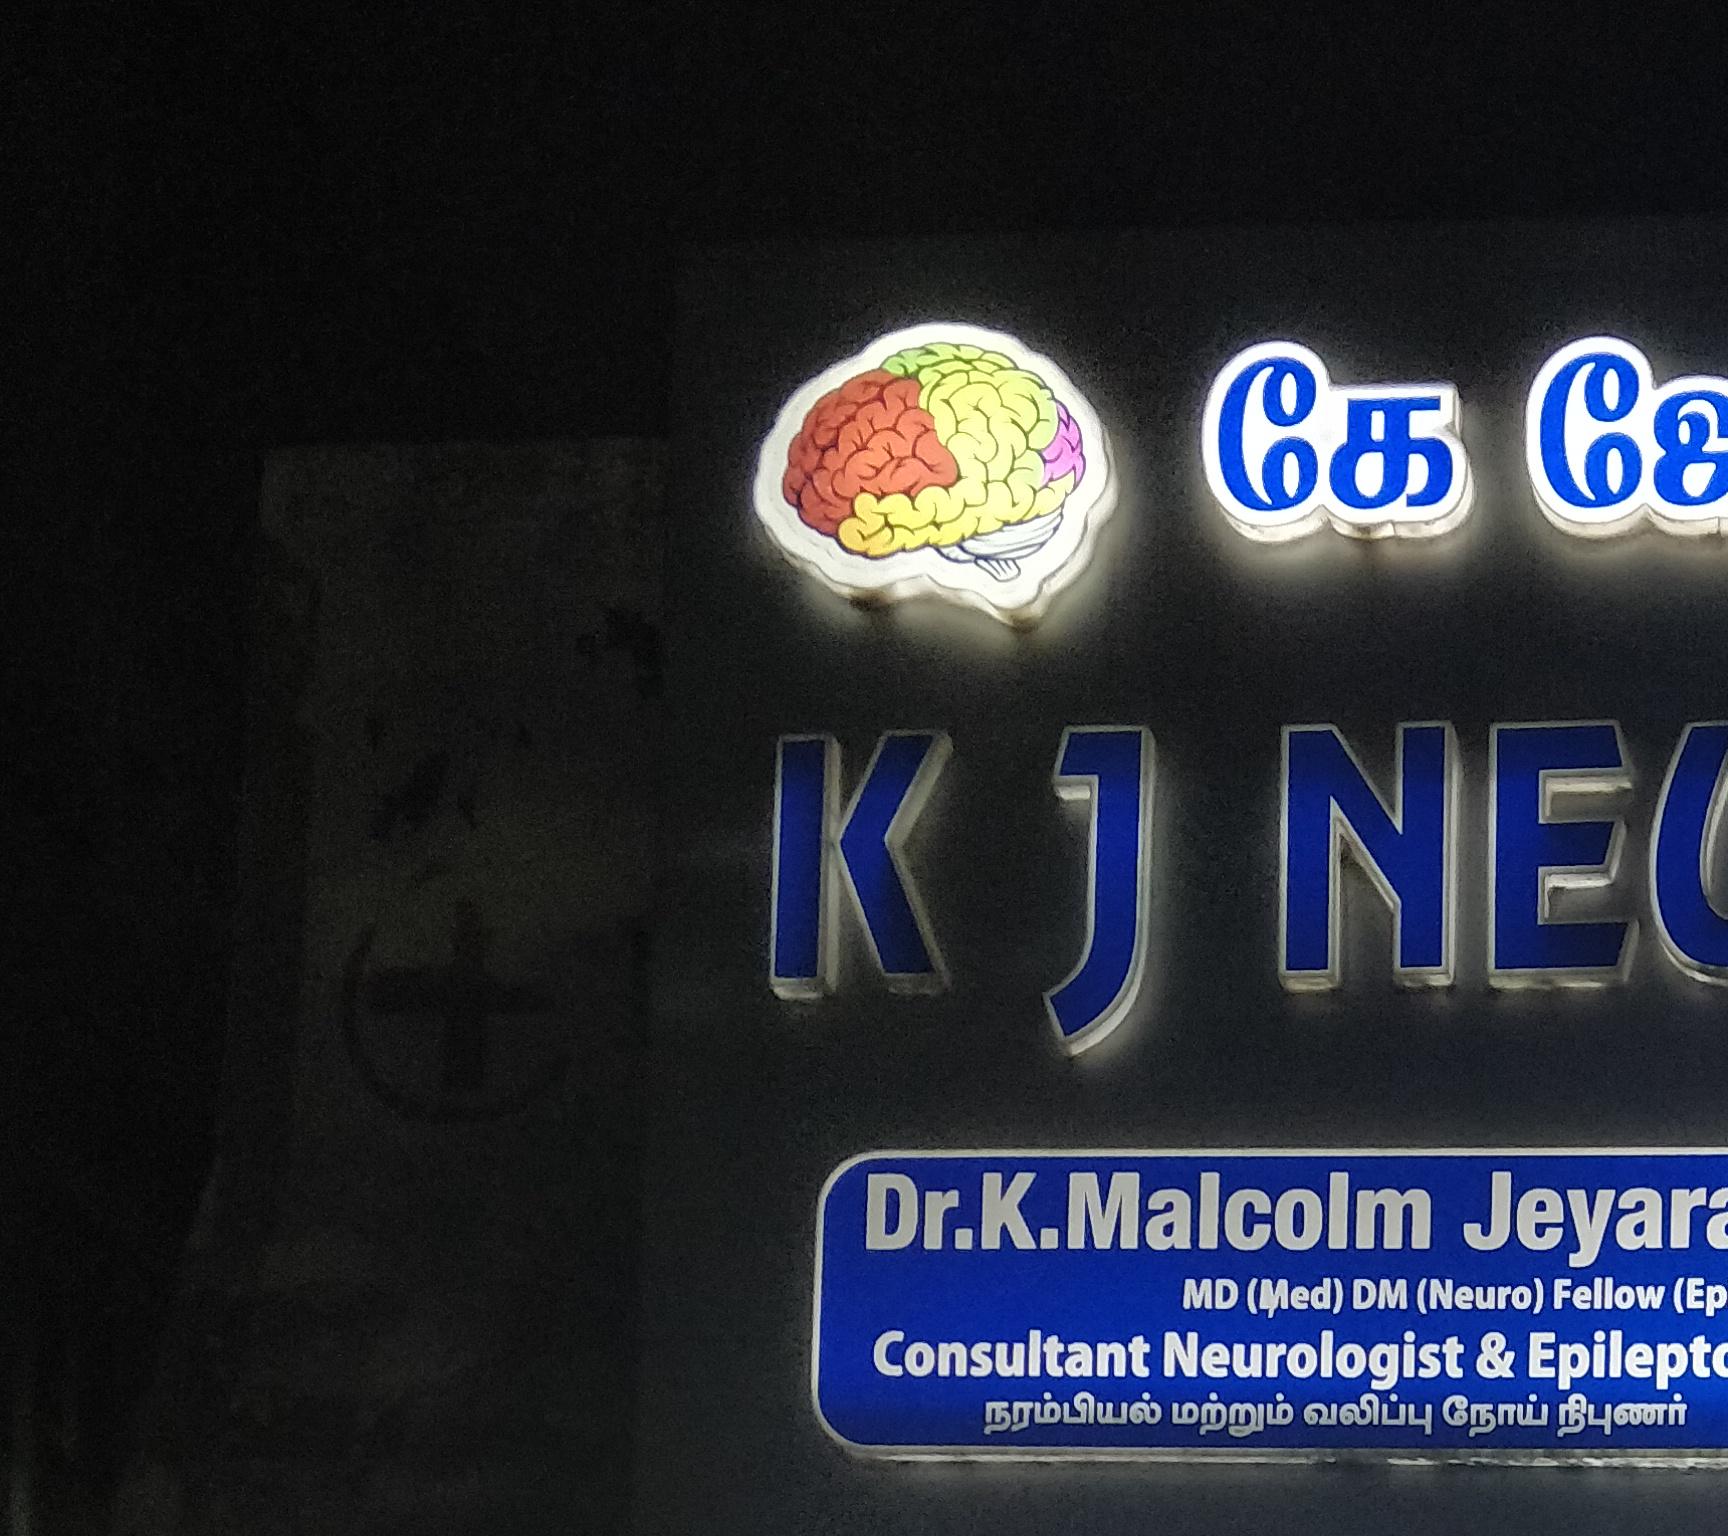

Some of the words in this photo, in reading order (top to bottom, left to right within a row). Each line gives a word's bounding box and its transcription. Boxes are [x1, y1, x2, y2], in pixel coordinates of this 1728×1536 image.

[1216, 352, 1458, 513] கே
[772, 730, 948, 985] K
[1042, 725, 1153, 1052] J
[864, 1171, 1433, 1251] Dr.K.Malcolm
[1183, 1278, 1239, 1310] MD
[1247, 1278, 1344, 1318] (Med)
[1352, 1278, 1408, 1310] DM
[1416, 1277, 1544, 1316] (Neuro)
[1553, 1277, 1665, 1310] Fellow
[872, 1329, 1152, 1379] Consultant
[1163, 1329, 1465, 1391] Neurologist
[1475, 1331, 1516, 1380] &
[983, 1391, 1163, 1436] நரம்பியல்
[1170, 1391, 1296, 1438] மற்றும்
[1303, 1393, 1434, 1437] வலிப்பு
[1442, 1392, 1550, 1439] நோய்
[1556, 1391, 1688, 1439] நிபுணர்
